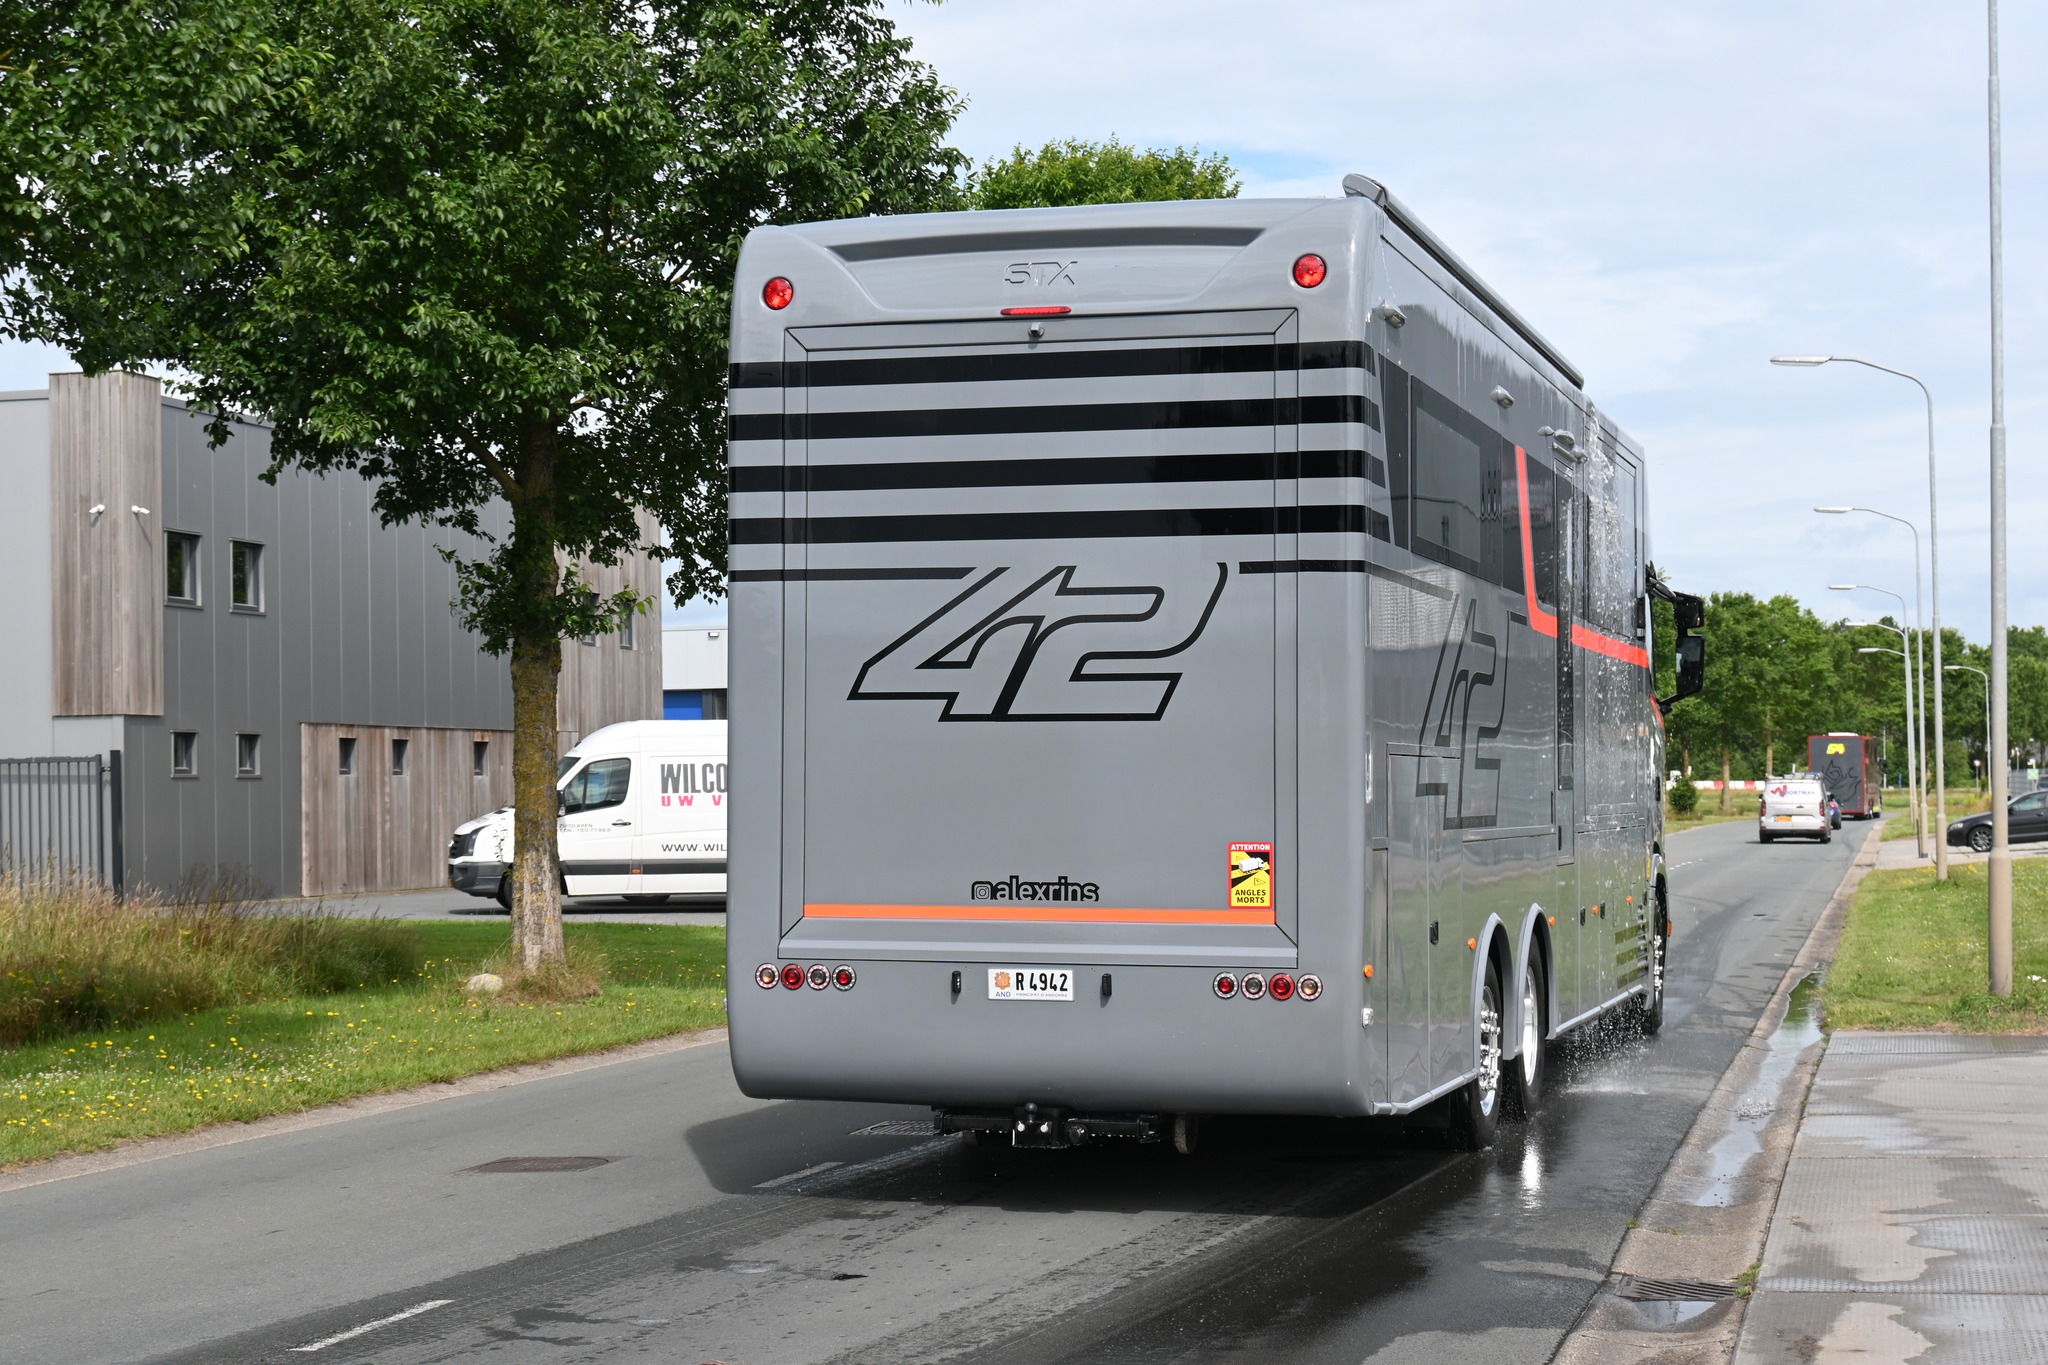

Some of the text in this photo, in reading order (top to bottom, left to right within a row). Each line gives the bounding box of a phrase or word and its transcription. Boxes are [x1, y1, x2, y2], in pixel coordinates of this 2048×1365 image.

[1004, 260, 1078, 287] STX
[846, 561, 1229, 722] 42
[994, 874, 1101, 902] alexrins
[1236, 896, 1265, 904] MORTS
[1029, 972, 1068, 992] 4942
